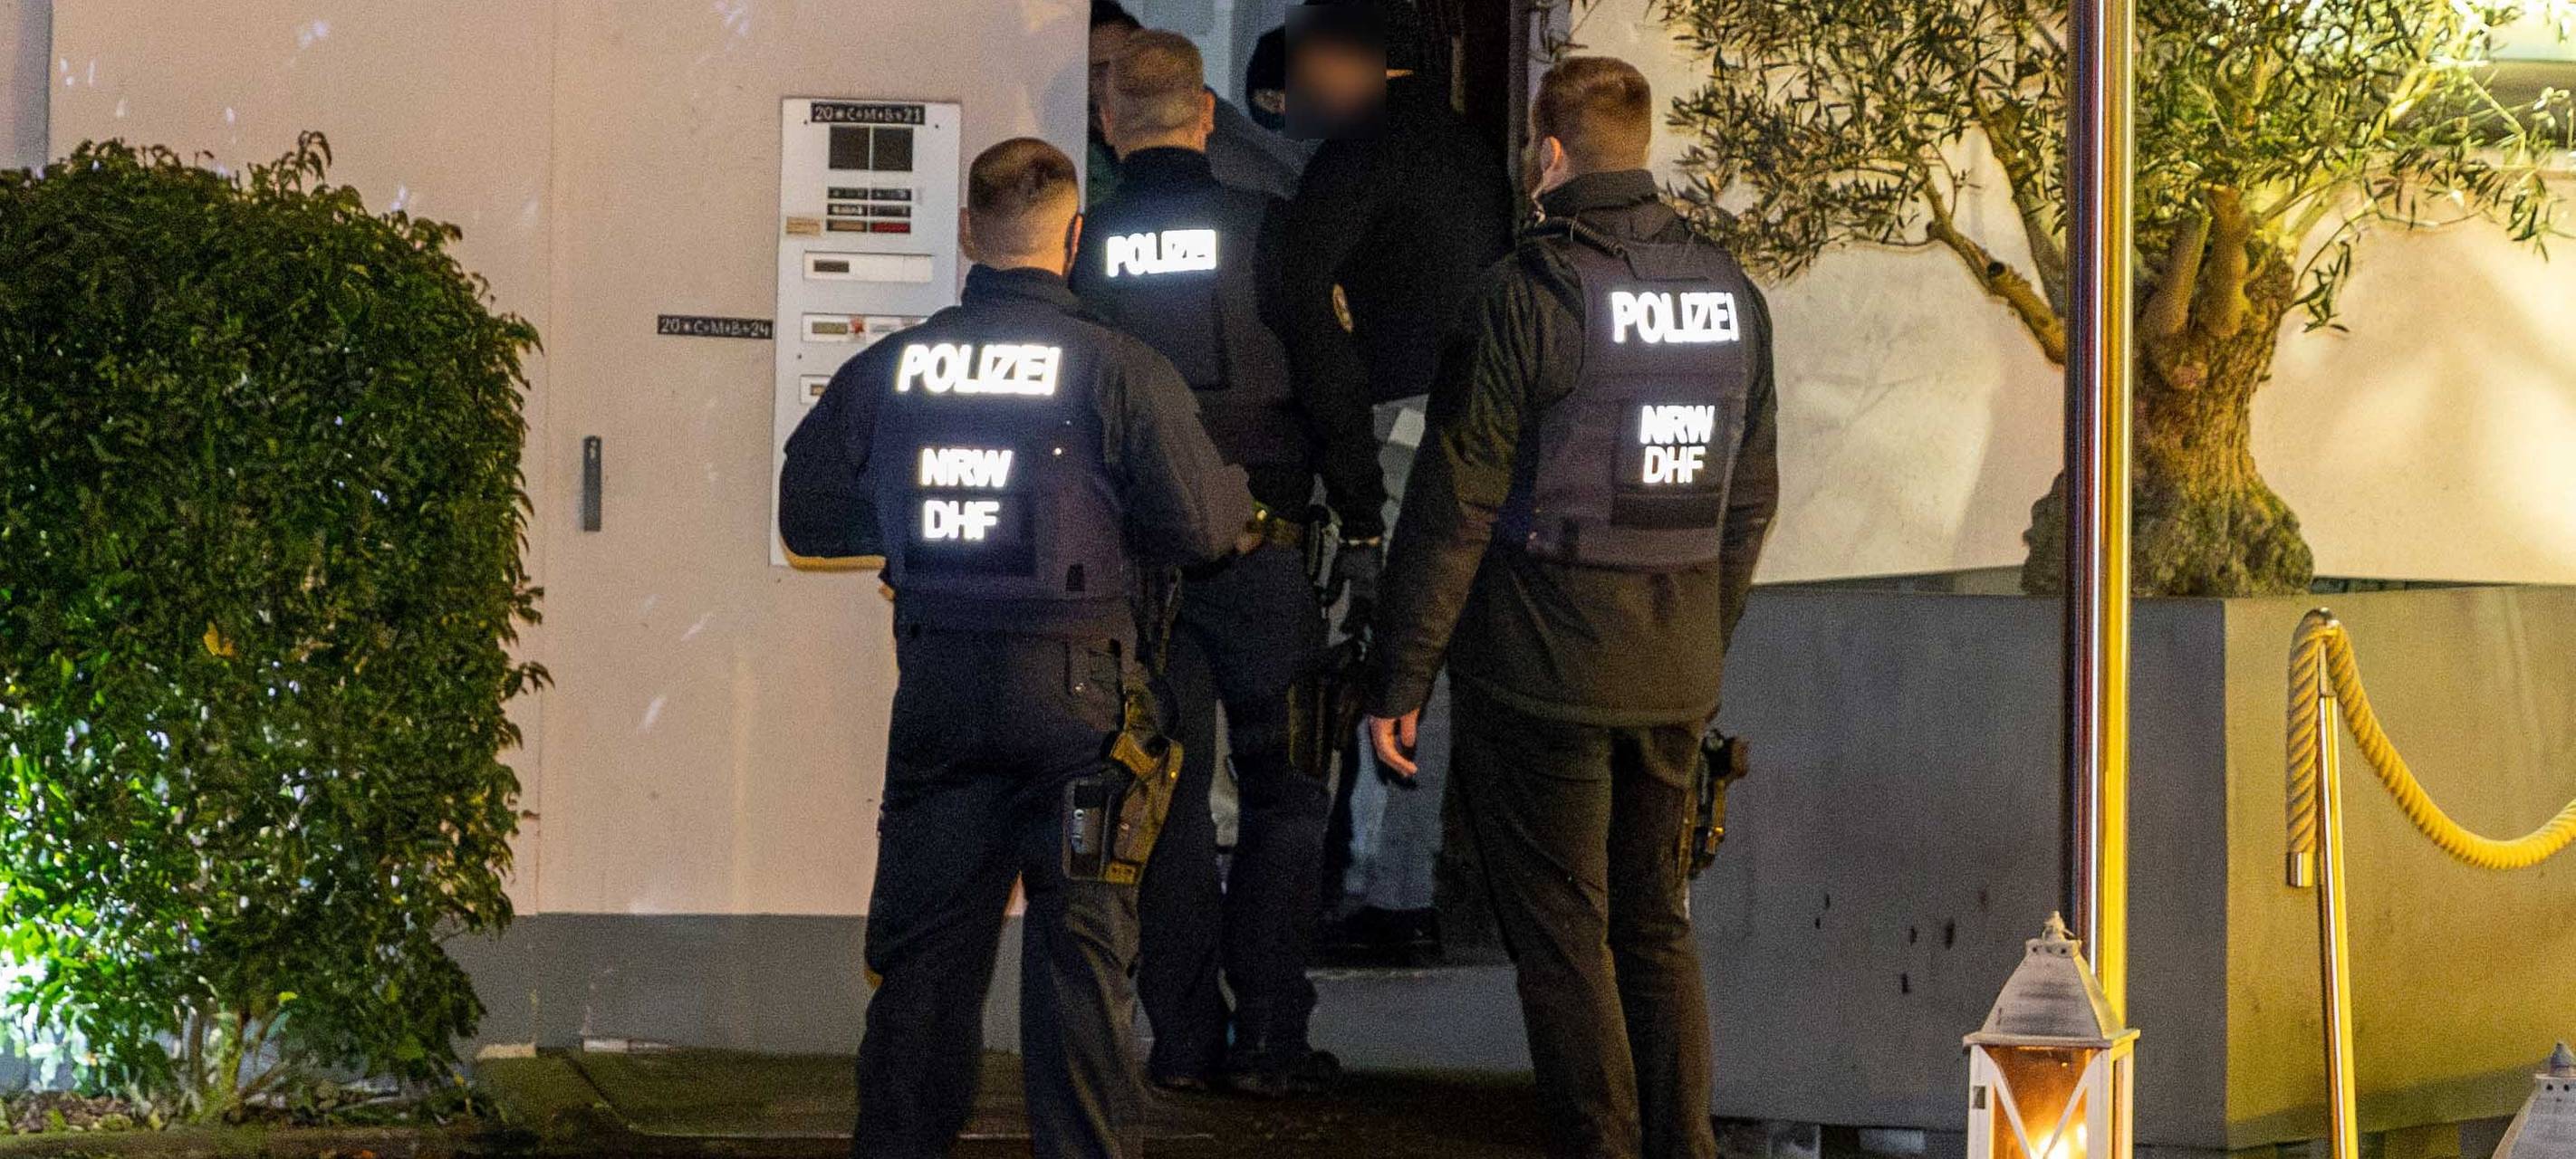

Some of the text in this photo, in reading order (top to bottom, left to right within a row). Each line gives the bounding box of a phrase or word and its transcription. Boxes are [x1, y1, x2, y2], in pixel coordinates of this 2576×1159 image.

[1107, 229, 1216, 277] POLIZEI
[1611, 292, 1739, 343] POLIZEI
[897, 343, 1061, 396] POLIZEI
[1640, 406, 1715, 444] NRW
[920, 448, 1013, 487] NRW
[1643, 445, 1706, 484] DHF
[923, 500, 1000, 540] DHF
